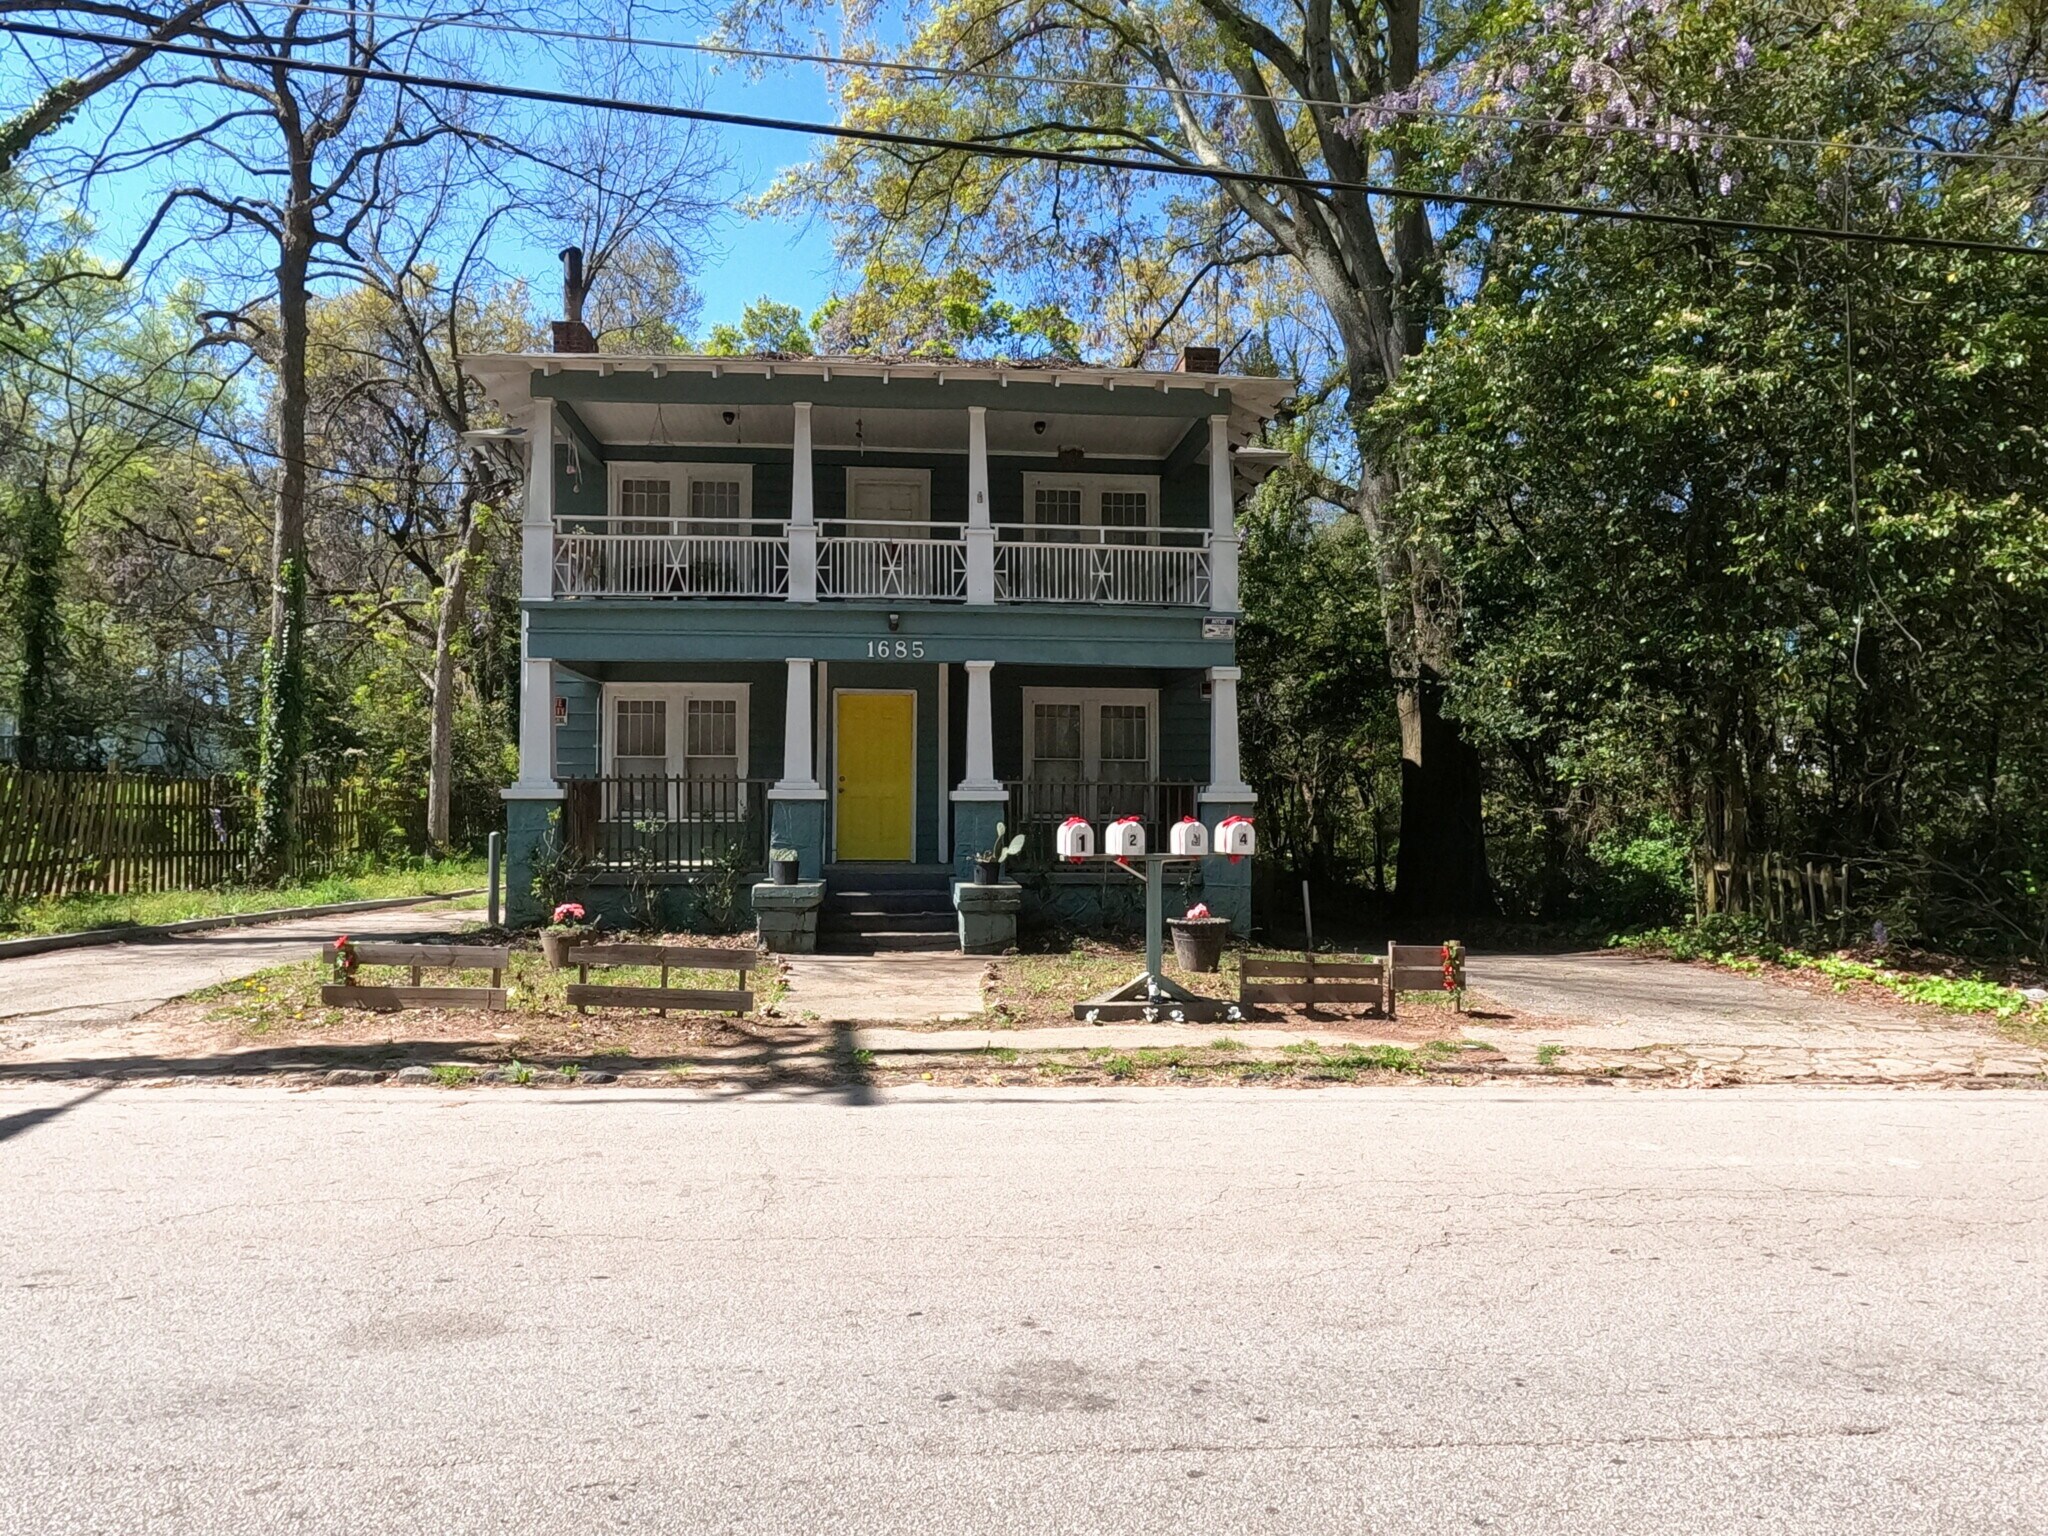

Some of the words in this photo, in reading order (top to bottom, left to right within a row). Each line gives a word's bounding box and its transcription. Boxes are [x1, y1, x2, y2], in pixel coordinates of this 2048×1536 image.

[867, 640, 925, 658] 1685
[1078, 834, 1086, 852] 1
[1129, 834, 1137, 846] 2
[1239, 833, 1248, 845] 4
